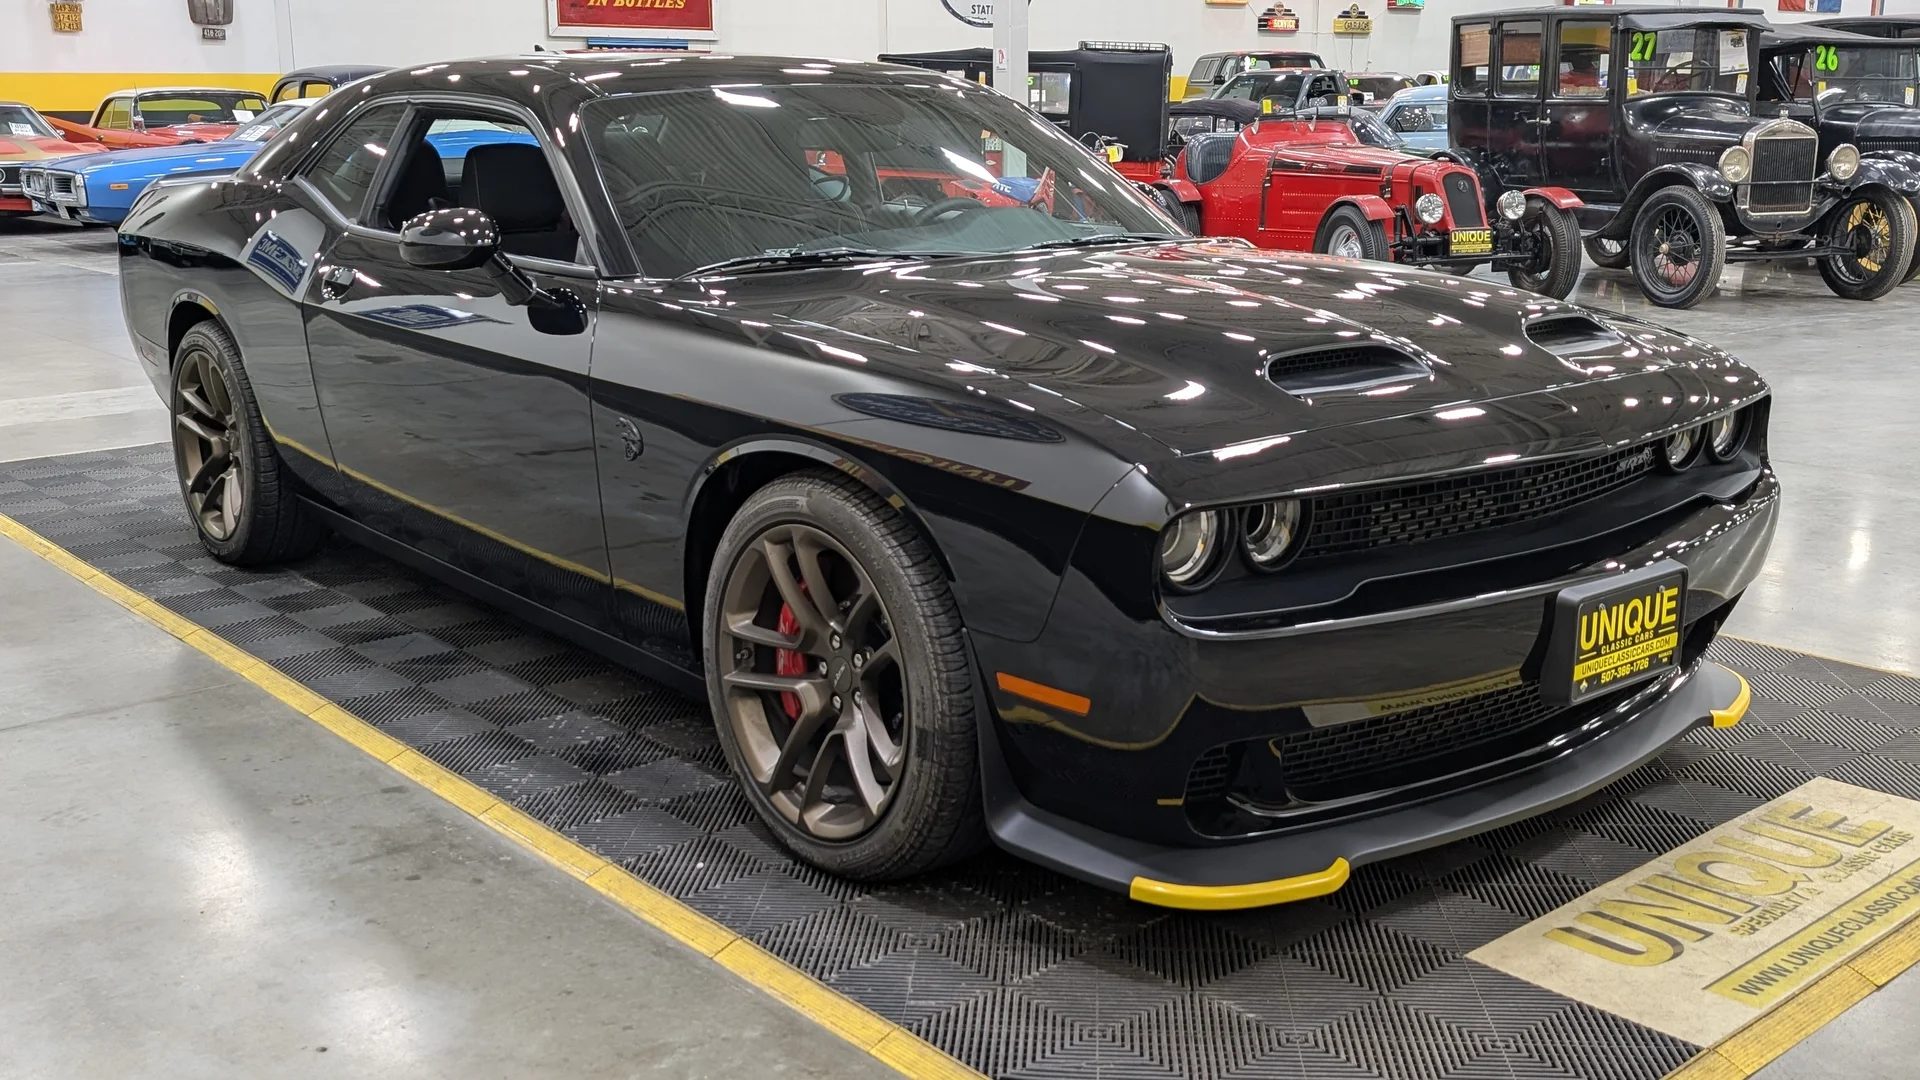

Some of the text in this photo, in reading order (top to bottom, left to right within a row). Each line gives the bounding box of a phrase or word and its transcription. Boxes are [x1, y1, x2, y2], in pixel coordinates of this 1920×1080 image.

[612, 0, 687, 9] BOTTLES
[971, 4, 993, 15] STATI
[1630, 31, 1656, 61] 27
[1816, 45, 1838, 71] 26
[992, 182, 1012, 193] ATC
[1451, 230, 1491, 242] UNIQUE
[1580, 587, 1679, 651] UNIQUE
[1601, 630, 1654, 655] CLASSIC CARS
[1581, 636, 1671, 676] UNIQUECLASSICCARS.COM
[1542, 800, 1896, 967] UNIQUE
